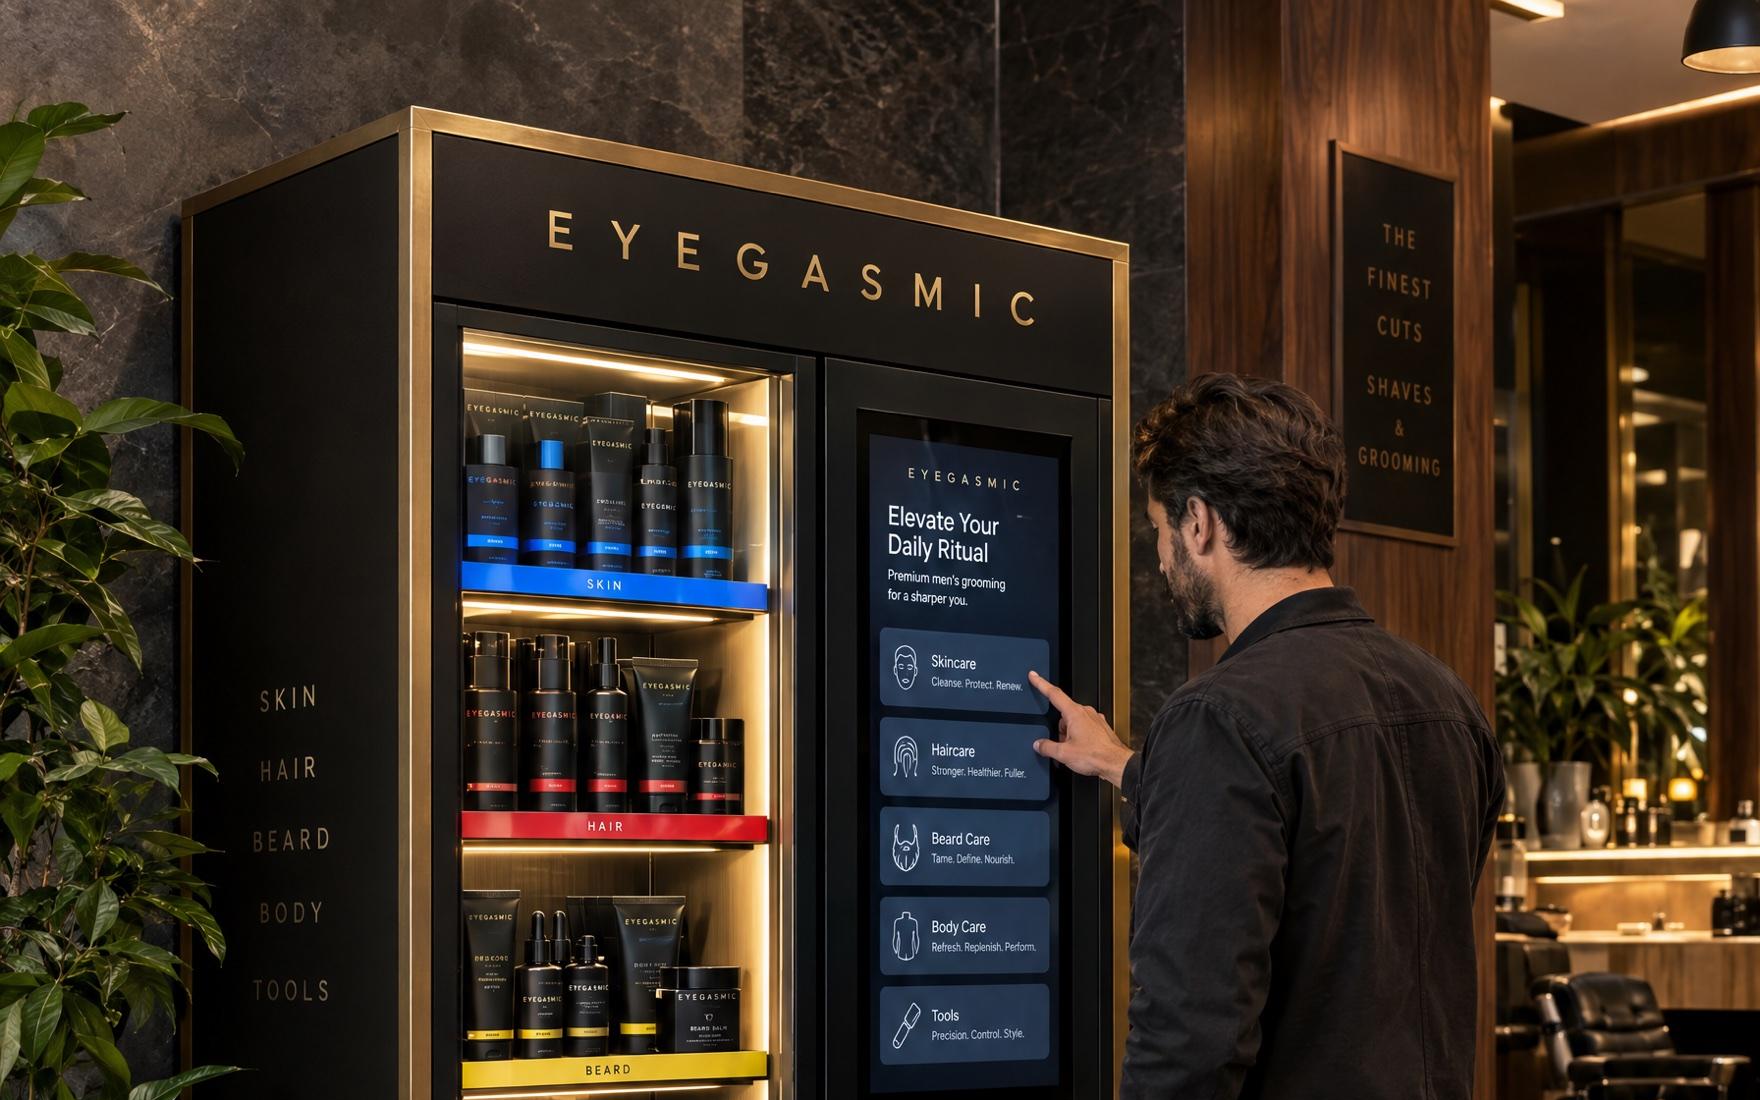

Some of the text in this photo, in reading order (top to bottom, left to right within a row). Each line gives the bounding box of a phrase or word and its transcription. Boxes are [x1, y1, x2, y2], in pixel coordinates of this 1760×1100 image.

[1383, 223, 1416, 250] THE
[548, 209, 1034, 326] EYEGASMIC
[1368, 267, 1432, 300] FINEST
[1377, 315, 1423, 343] CUTS
[1367, 375, 1432, 405] SHAVES
[529, 410, 579, 423] EYEGASMIC
[1394, 419, 1405, 437] &
[1358, 446, 1441, 477] GROOMING
[908, 467, 1020, 491] EYEGASMIC
[888, 505, 1000, 536] Elevate Your
[888, 533, 988, 563] Daily Ritual
[587, 578, 622, 591] SKIN
[888, 568, 1006, 593] Premium men's grooming
[888, 588, 968, 607] for a sharper you.
[931, 654, 977, 670] Skincare
[642, 682, 691, 690] EYEGASMIC
[931, 676, 1023, 692] Cleanse. Protect. Renew.
[260, 684, 315, 713] SKIN
[931, 743, 975, 758] Haircare
[260, 755, 316, 782] HAIR
[931, 765, 1027, 779] Stronger. Healthier. Fuller.
[587, 821, 623, 832] HAIR
[253, 827, 329, 853] BEARD
[931, 831, 990, 846] Beard Care
[931, 853, 1015, 865] Tame. Define. Nourish.
[260, 901, 322, 924] BODY
[625, 918, 677, 926] EYEGASMIC
[931, 920, 986, 936] Body Care
[931, 942, 1036, 954] Refresh. Replenish. Perform.
[253, 979, 329, 1002] TOOLS
[678, 993, 737, 1001] EYEGASMIC
[931, 1009, 959, 1022] Tools
[931, 1028, 1025, 1041] Precision. Control. Style.
[586, 1064, 631, 1076] BEARD
